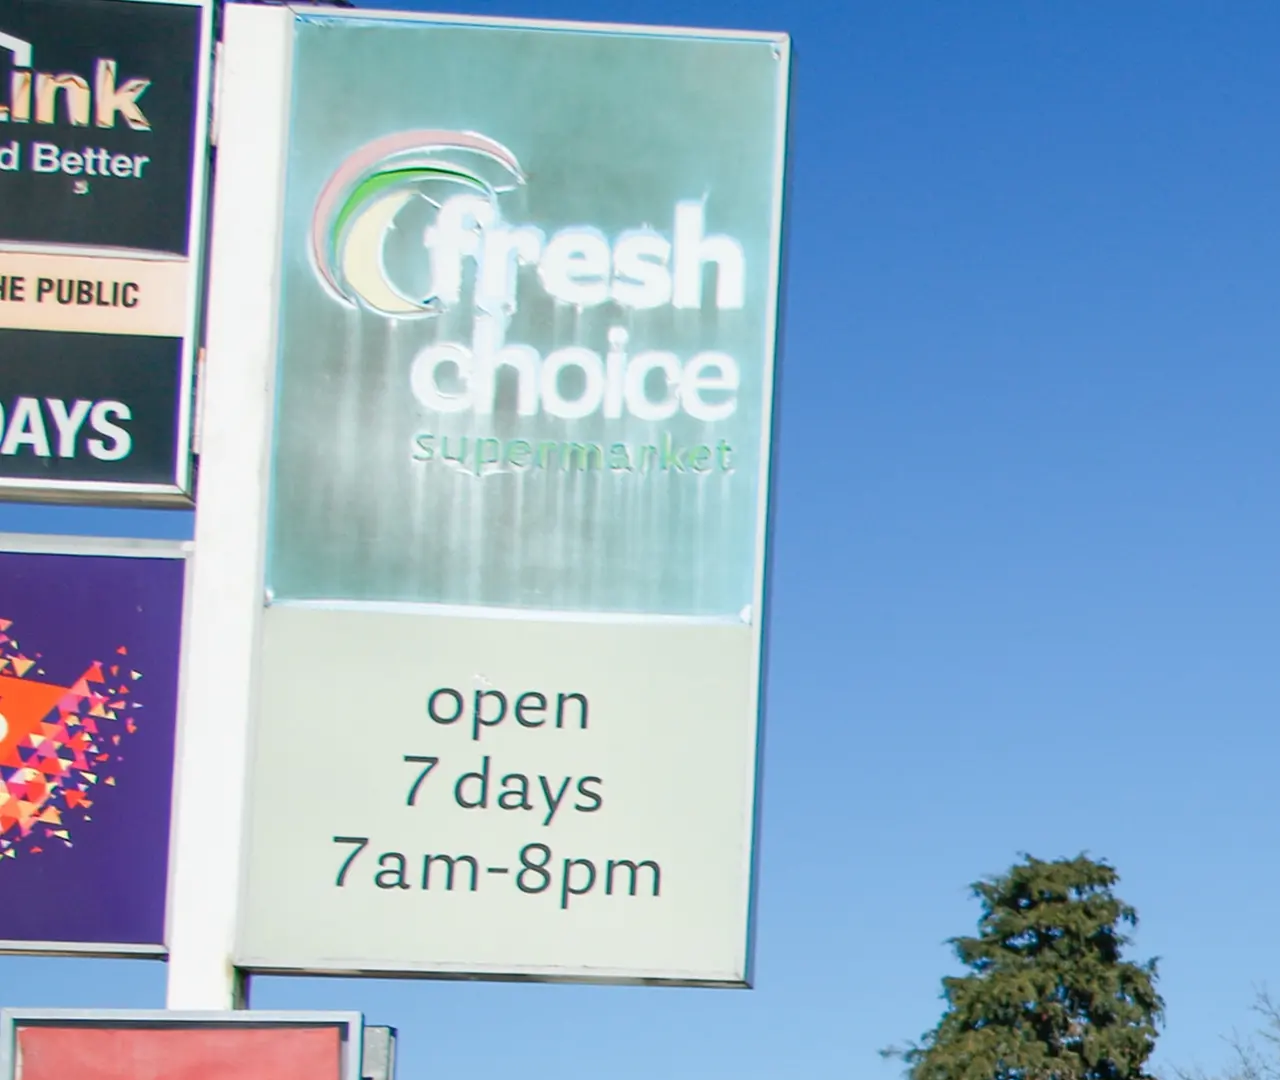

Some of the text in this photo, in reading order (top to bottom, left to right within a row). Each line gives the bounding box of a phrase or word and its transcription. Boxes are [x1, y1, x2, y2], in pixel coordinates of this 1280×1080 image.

[0, 58, 152, 131] ink
[32, 142, 150, 178] Better
[424, 194, 745, 310] fresh
[37, 277, 140, 308] PUBLIC
[411, 312, 740, 421] choice
[0, 397, 133, 460] AYS
[411, 430, 735, 476] supermarket
[427, 687, 589, 741] open
[403, 755, 603, 826] 7 days
[333, 836, 661, 909] 7am-8pm
